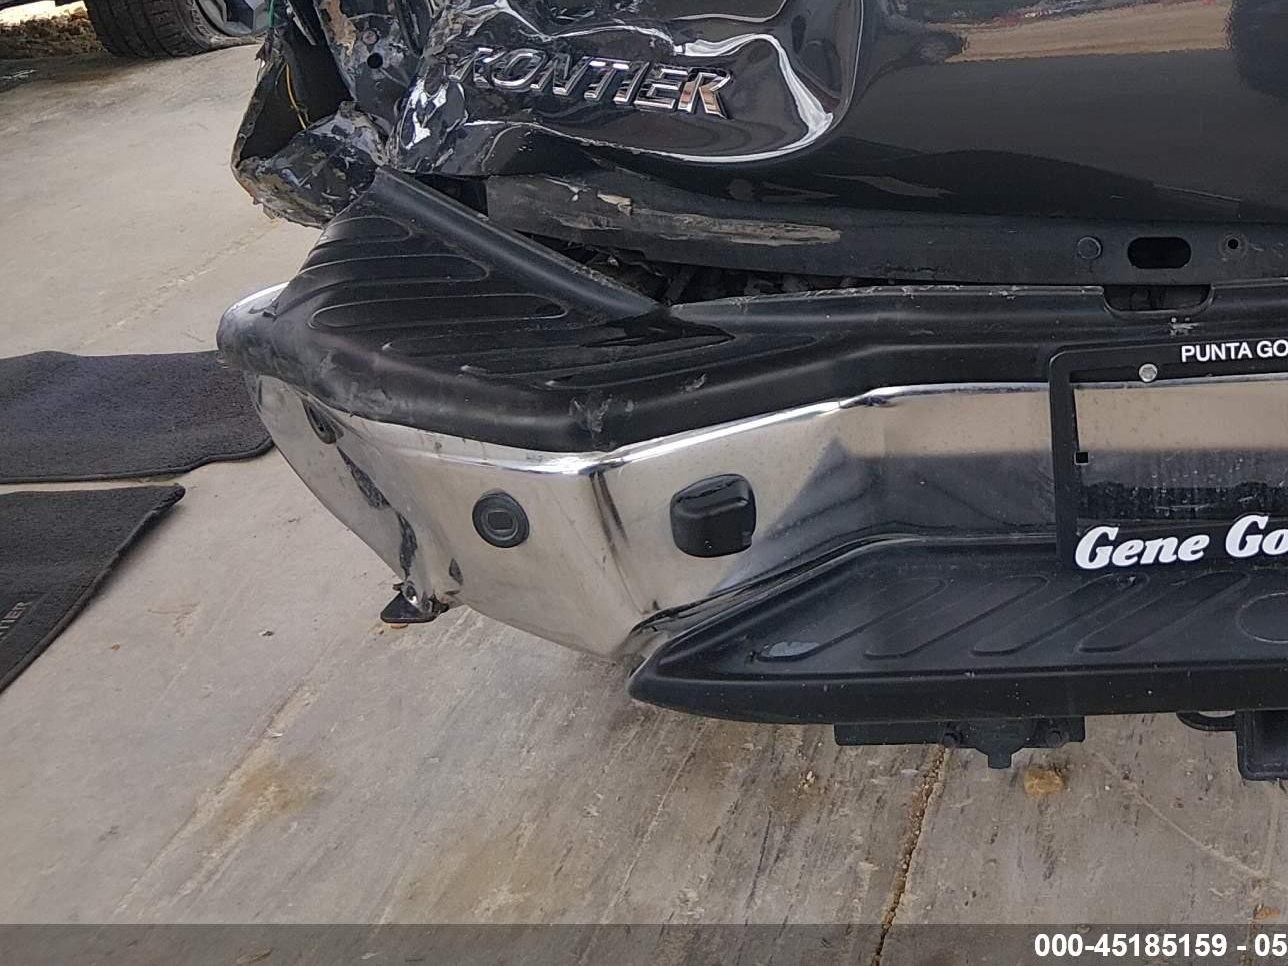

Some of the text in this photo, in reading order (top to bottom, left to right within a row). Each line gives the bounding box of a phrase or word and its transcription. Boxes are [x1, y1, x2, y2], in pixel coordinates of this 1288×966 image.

[449, 46, 733, 120] RONTIER
[1181, 342, 1252, 363] PUNTA
[1074, 524, 1210, 570] Gene
